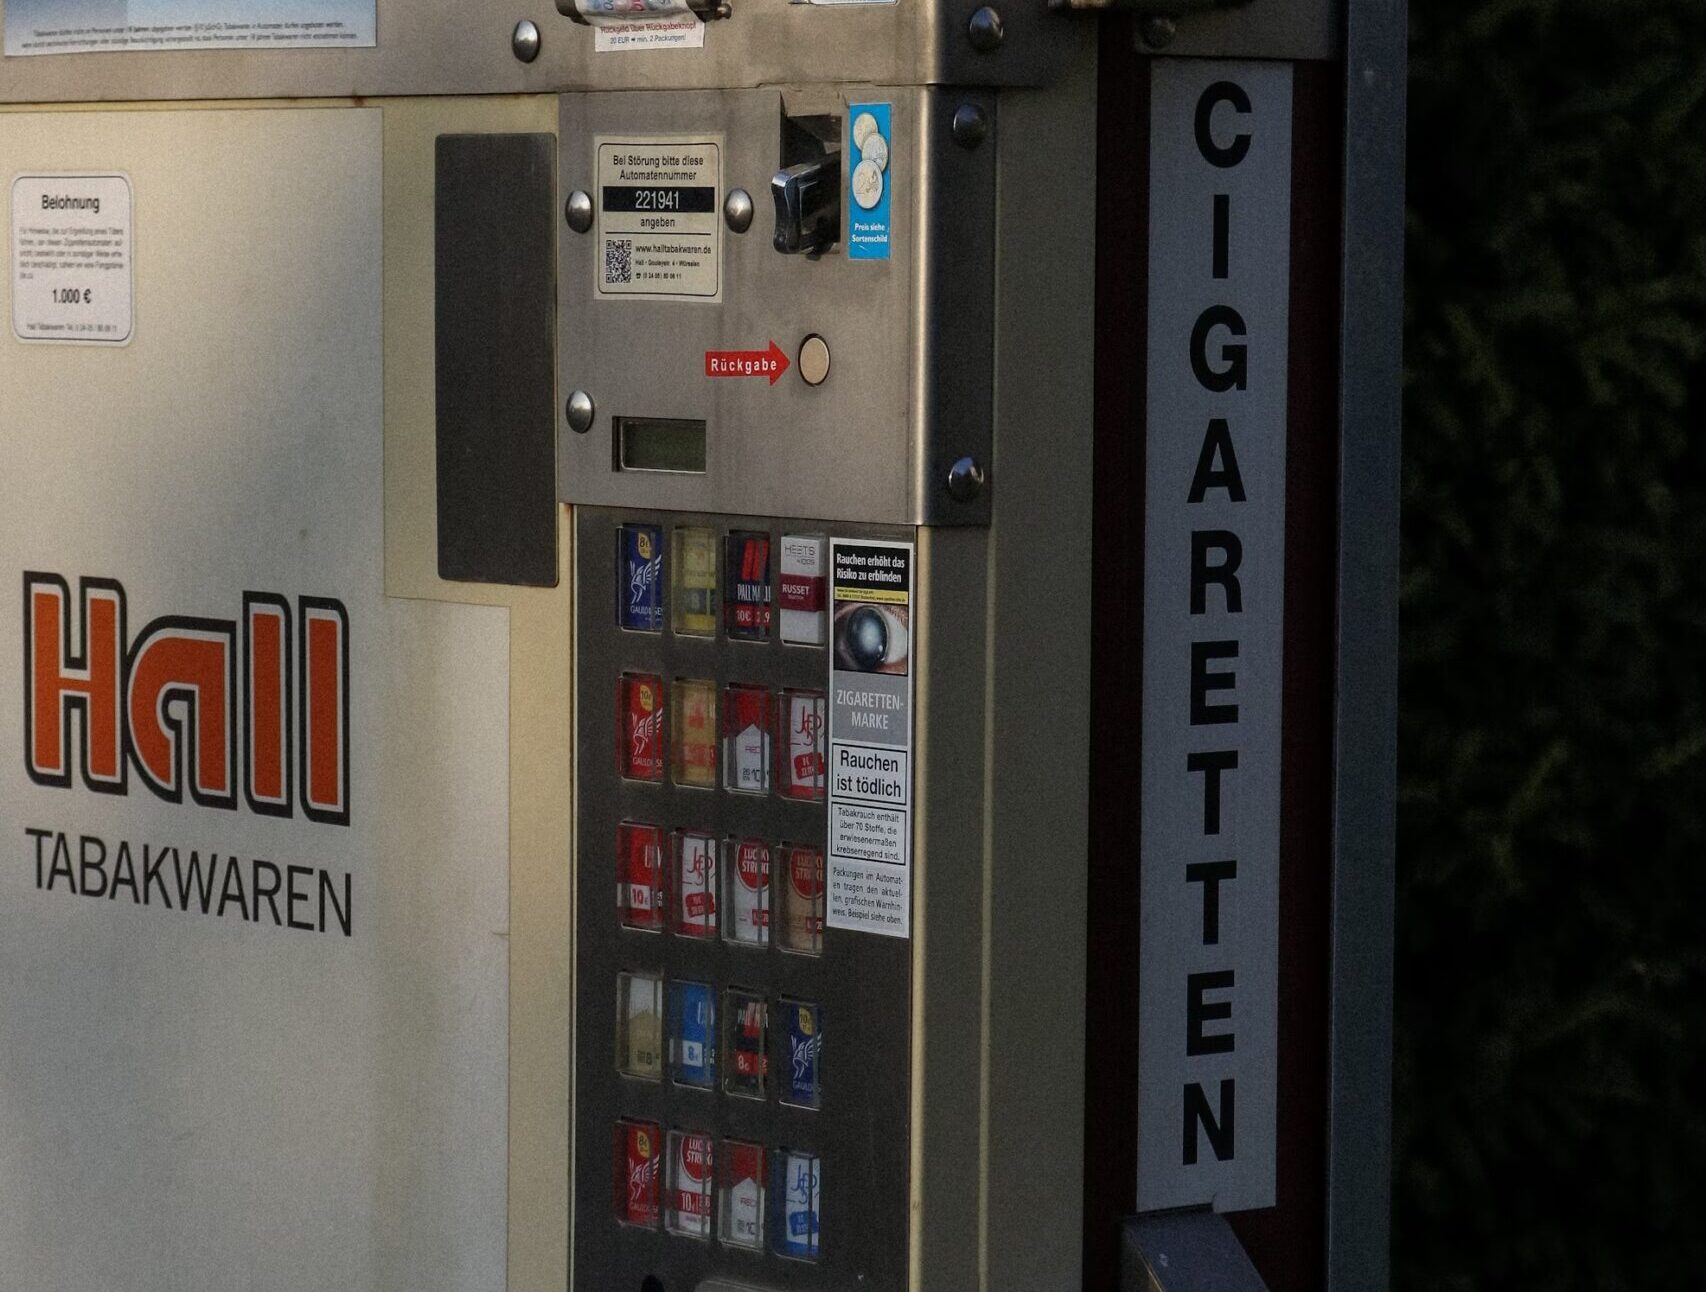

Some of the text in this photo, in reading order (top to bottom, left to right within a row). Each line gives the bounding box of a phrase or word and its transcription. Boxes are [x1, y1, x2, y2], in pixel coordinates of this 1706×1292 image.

[613, 155, 704, 168] Bei Störung bitte diese
[620, 170, 697, 180] Automatennummer
[42, 194, 100, 214] Belohnung
[635, 190, 680, 209] 221941
[640, 216, 676, 229] angeben
[854, 222, 885, 232] Preis siehe
[852, 234, 888, 244] Sortenschild
[52, 289, 92, 304] 1.000 €
[711, 358, 777, 375] Rückgabe
[784, 544, 816, 556] HEETS
[836, 554, 905, 568] Rauchen erhöht das
[836, 568, 902, 583] Risiko zu erblinden
[782, 583, 810, 596] RUSSET
[1182, 81, 1253, 1166] CIGARETTEN
[23, 570, 350, 827] Hall
[836, 690, 904, 710] ZIGARETTEN-
[852, 712, 888, 729] MARKE
[840, 750, 898, 772] Rauchen
[837, 774, 901, 797] ist tödlich
[838, 808, 899, 823] Tabakrauch enthält
[840, 820, 854, 830] über
[856, 822, 863, 830] 70
[888, 826, 897, 835] die
[840, 834, 897, 847] erwiesenermaßen
[836, 844, 899, 860] krebserregend sind.
[833, 867, 864, 880] Packungen
[866, 870, 873, 880] im
[25, 828, 352, 937] TABAKWAREN
[844, 883, 863, 893] tragen
[867, 885, 878, 894] den
[844, 896, 874, 907] grafischen
[848, 908, 869, 920] Beispiel
[871, 912, 885, 922] siehe
